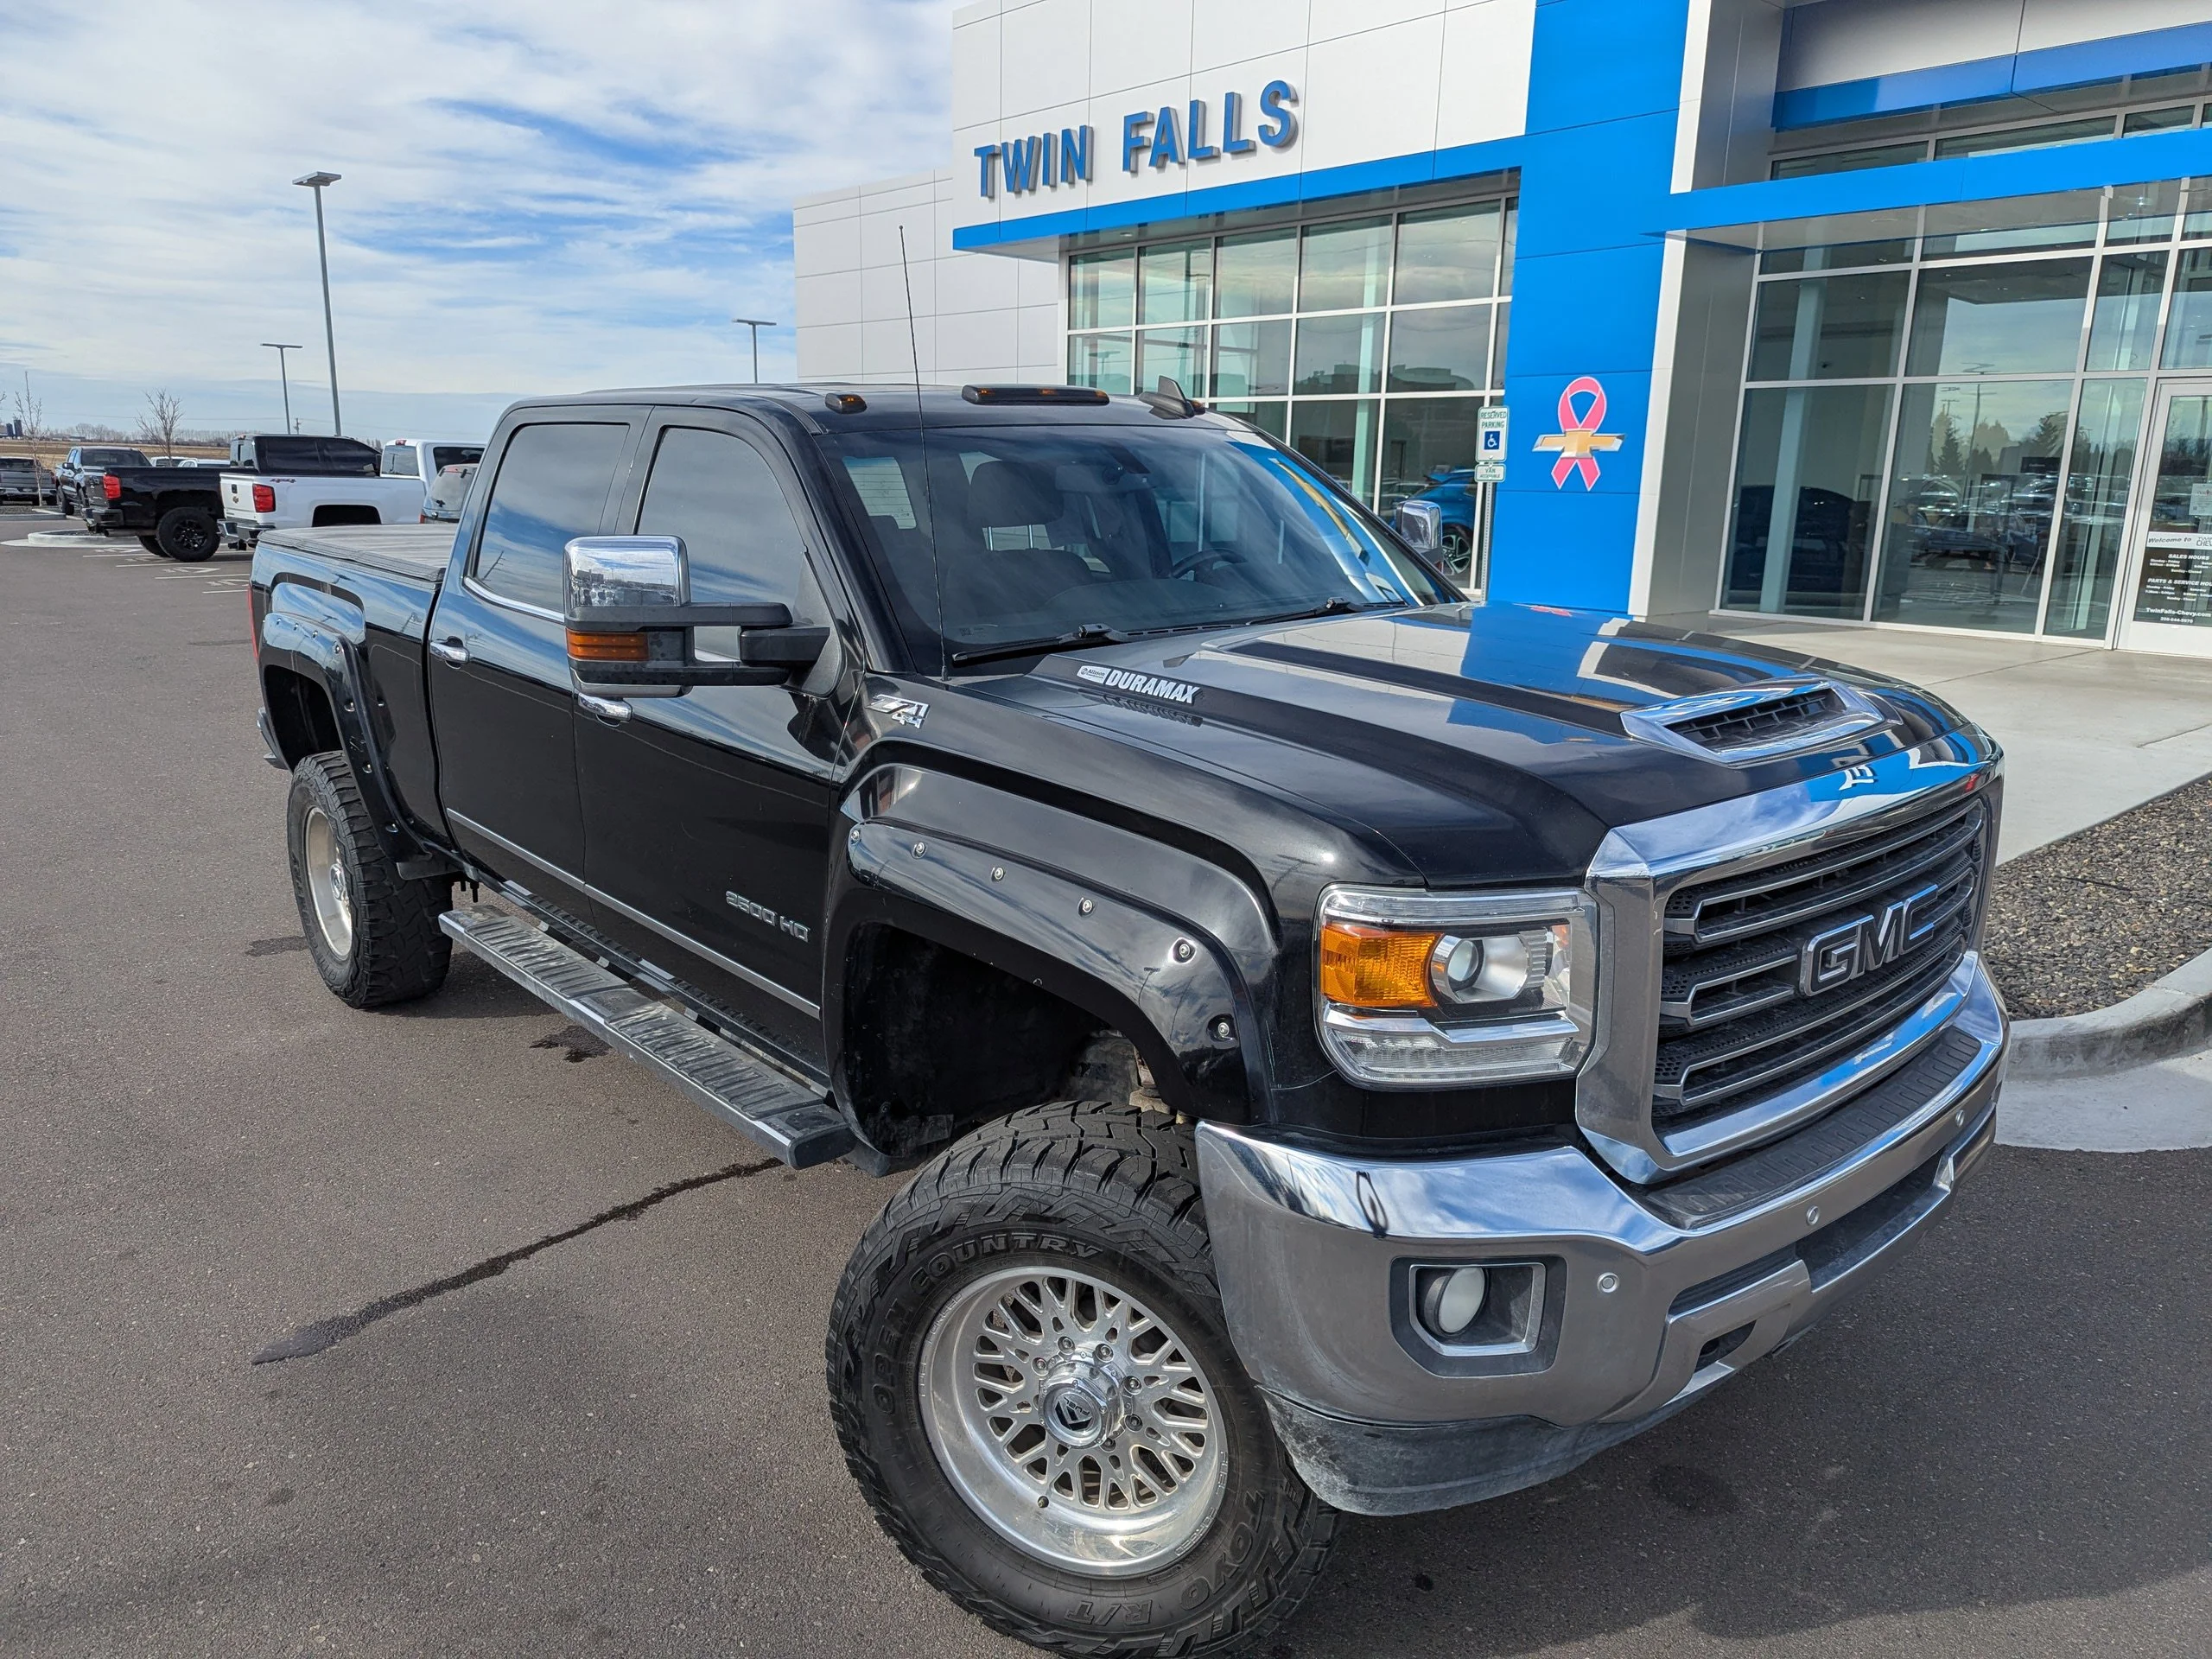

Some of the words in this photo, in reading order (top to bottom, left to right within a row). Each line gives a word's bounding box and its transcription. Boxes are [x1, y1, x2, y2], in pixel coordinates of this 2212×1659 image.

[974, 124, 1093, 200] TWIN
[1122, 79, 1299, 175] FALLS
[1481, 421, 1505, 429] PARKING
[1105, 669, 1200, 704] DURAMAX
[726, 890, 777, 927] 2500
[779, 915, 811, 943] HD
[1799, 883, 1938, 997] GMC
[910, 1231, 1103, 1294] COUNTRY
[1063, 1396, 1090, 1416] FUEL
[1180, 1490, 1265, 1611] TOYO
[1064, 1599, 1154, 1626] R/T
